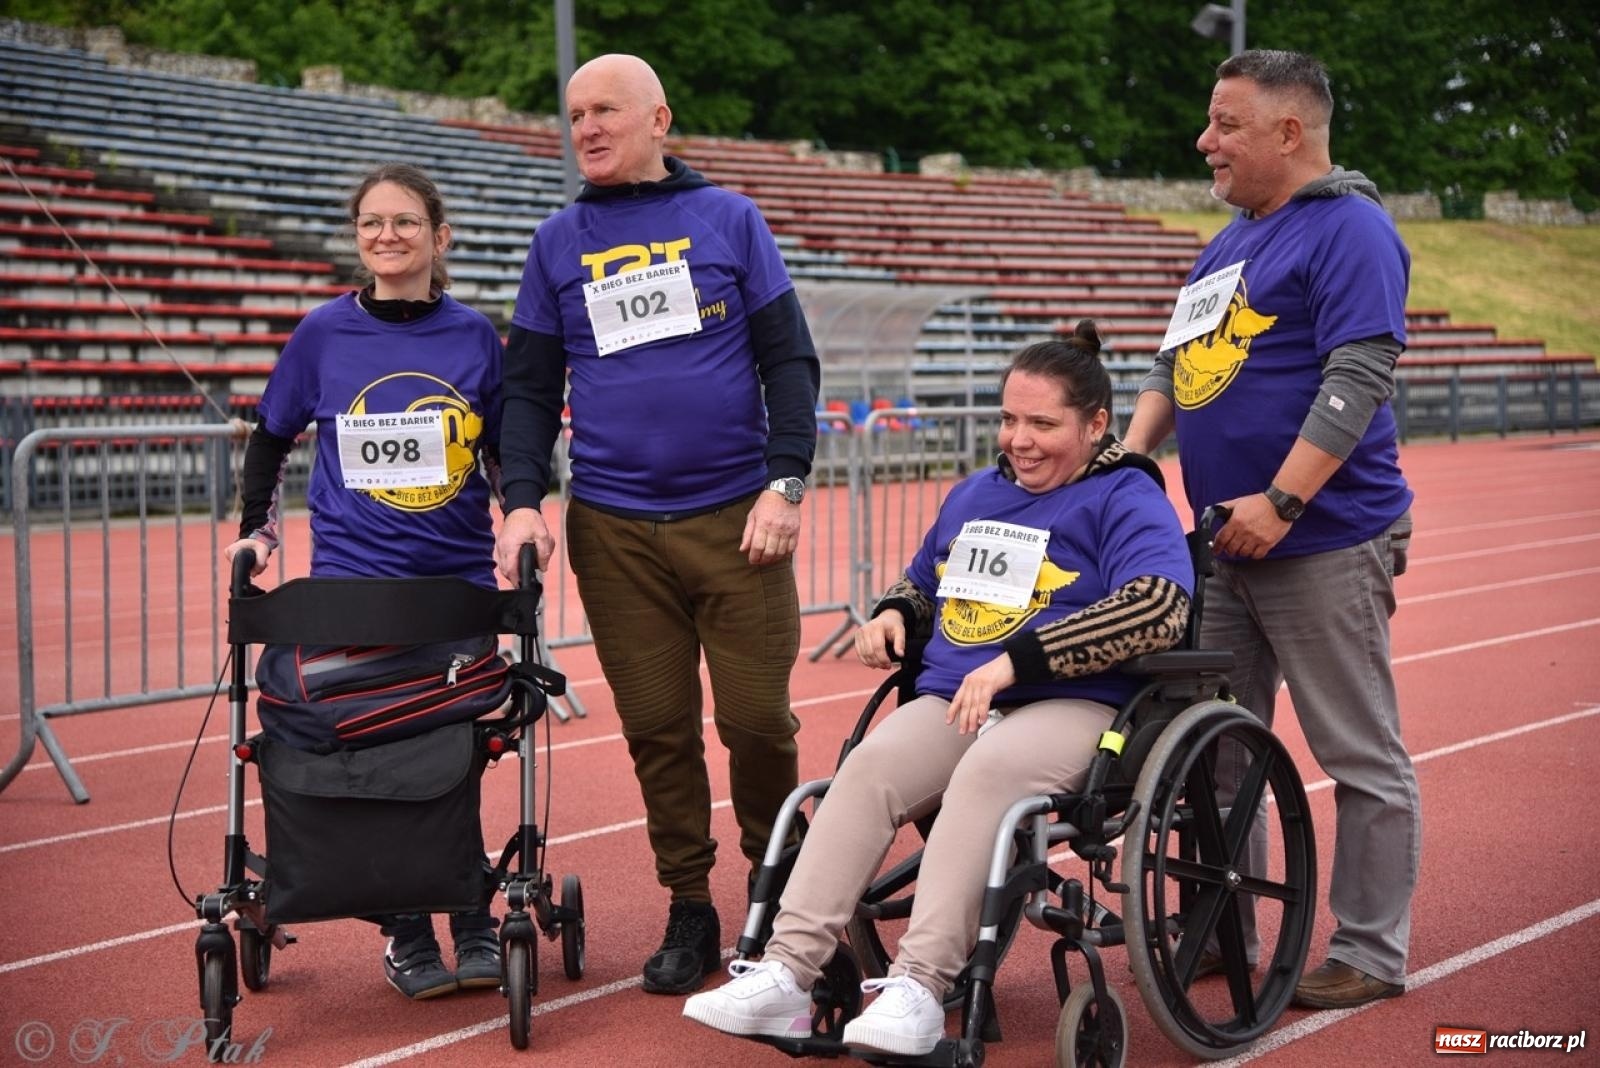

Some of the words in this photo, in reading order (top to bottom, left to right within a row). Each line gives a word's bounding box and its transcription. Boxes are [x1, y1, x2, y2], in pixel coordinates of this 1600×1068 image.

[592, 286, 600, 294] X
[601, 278, 623, 291] BIEG
[625, 273, 645, 284] BEZ
[646, 266, 681, 278] BARIER
[616, 290, 669, 322] 102
[1188, 293, 1220, 323] 120
[353, 419, 376, 427] BIEG
[378, 418, 398, 427] BEZ
[400, 416, 435, 425] BARIER
[361, 438, 421, 464] 098
[396, 490, 416, 503] BIEG
[417, 491, 433, 503] BEZ
[984, 525, 1001, 536] BEZ
[1003, 528, 1040, 543] BARIER
[968, 548, 1009, 577] 116
[962, 626, 976, 638] BEZ
[977, 618, 1006, 638] BARIER
